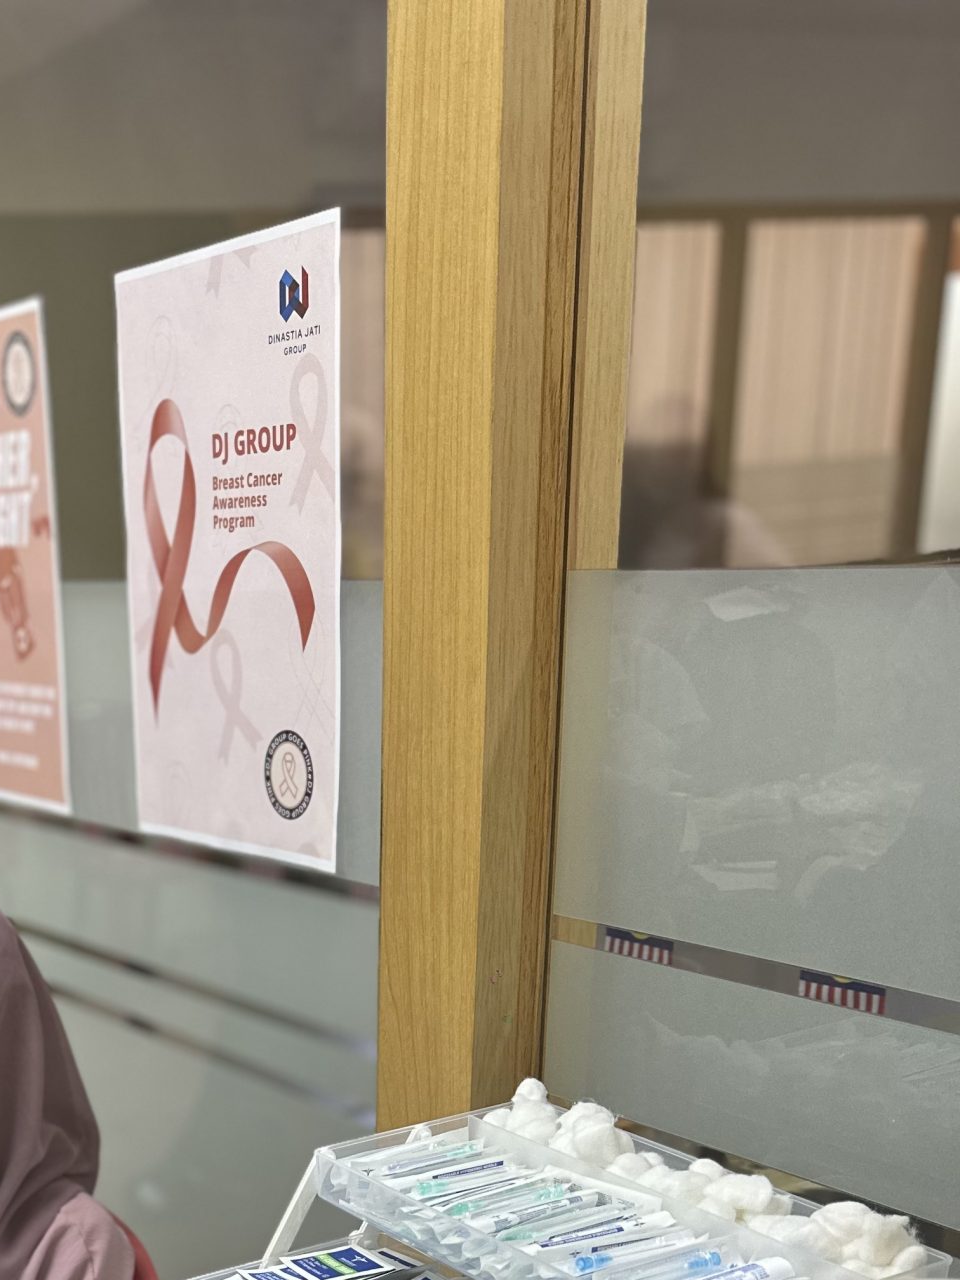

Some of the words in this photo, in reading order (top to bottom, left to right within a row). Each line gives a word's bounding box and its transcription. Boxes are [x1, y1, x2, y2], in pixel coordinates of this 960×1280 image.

[268, 329, 303, 345] DINASTIA
[304, 325, 321, 339] JATI
[283, 344, 307, 356] GROUP
[212, 431, 229, 465] DJ
[234, 423, 297, 457] GROUP
[212, 474, 245, 491] Breast
[246, 471, 283, 488] Cancer
[212, 494, 268, 510] Awareness
[213, 514, 255, 533] Program
[268, 733, 287, 755] GROUP
[288, 733, 303, 750] GOES
